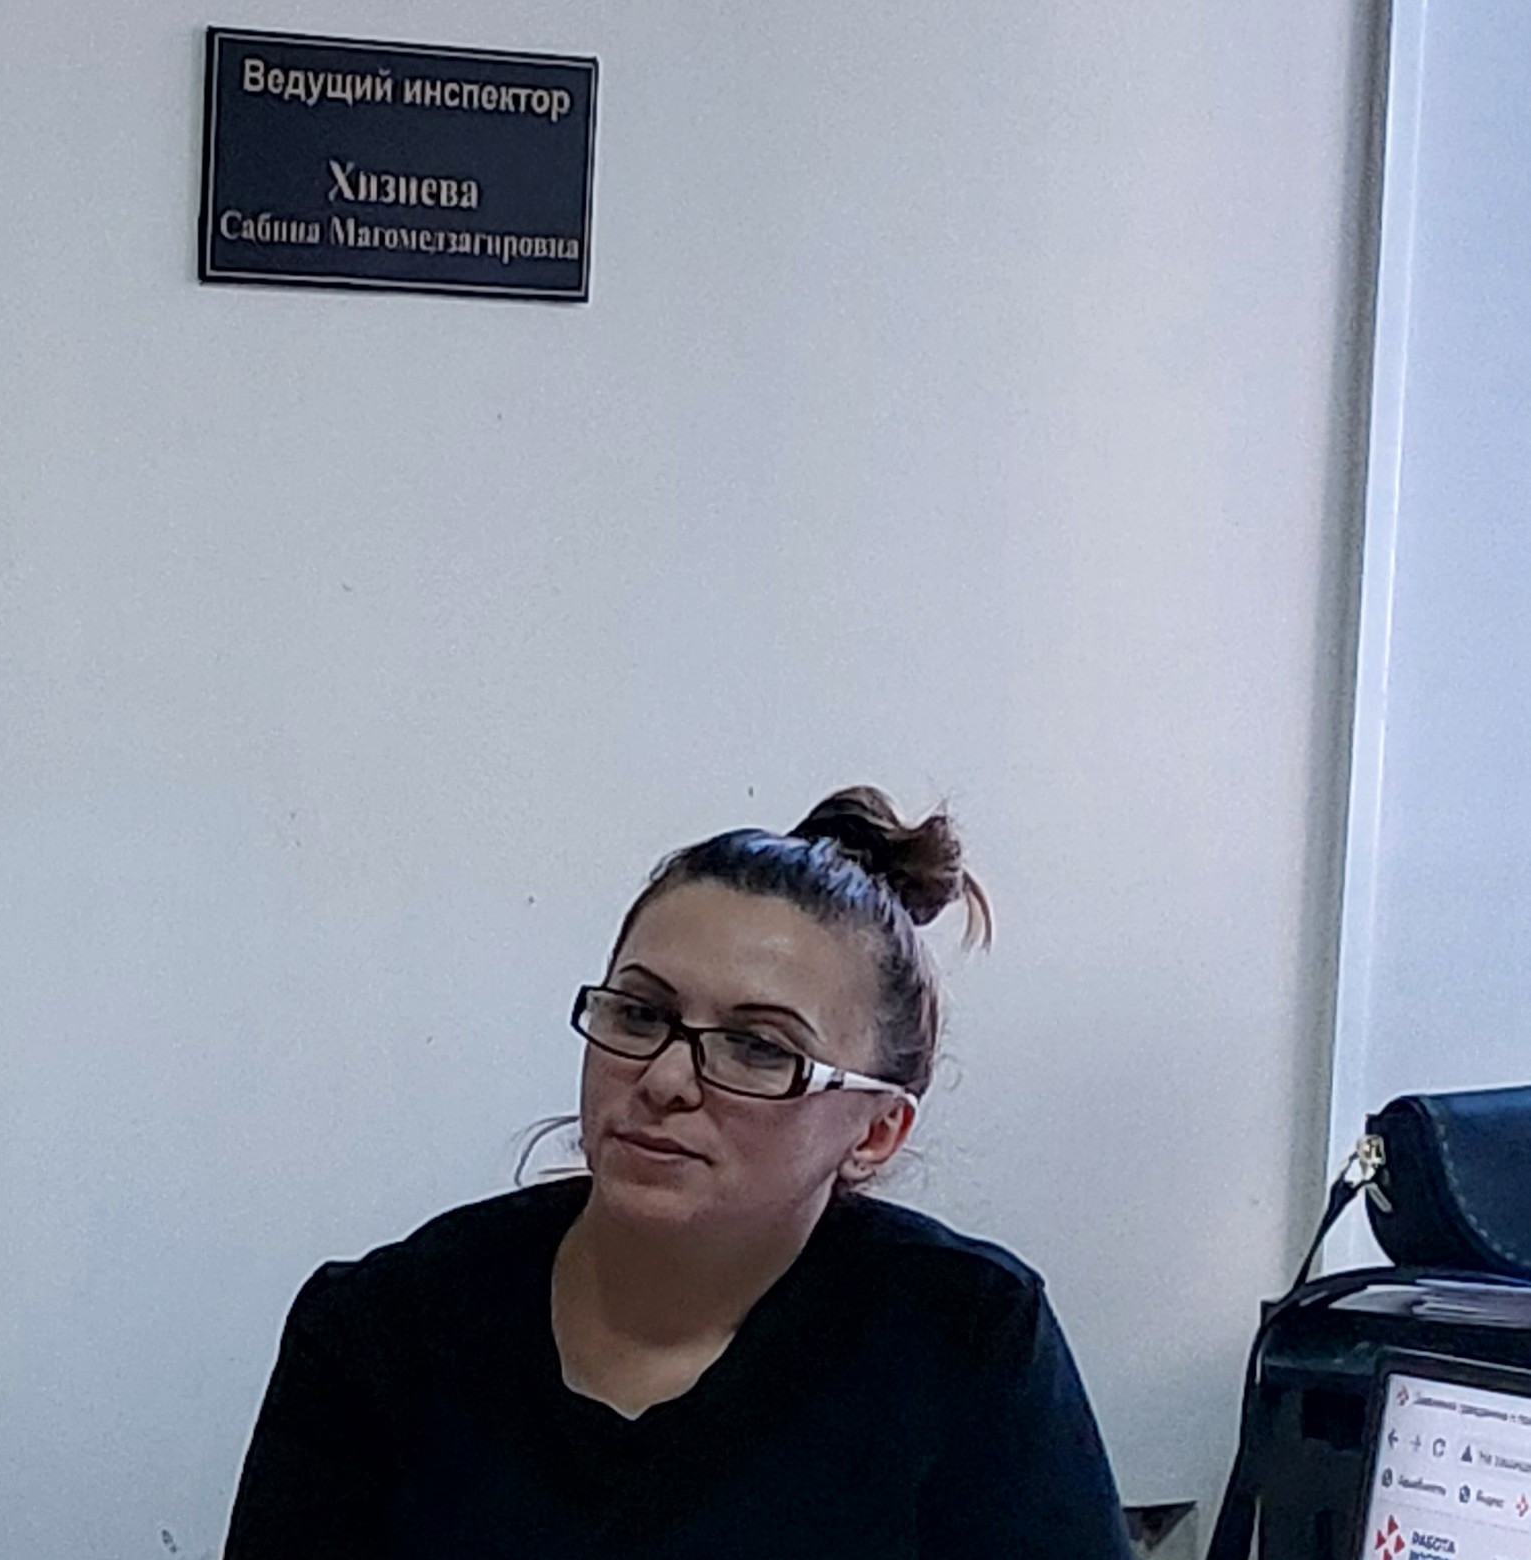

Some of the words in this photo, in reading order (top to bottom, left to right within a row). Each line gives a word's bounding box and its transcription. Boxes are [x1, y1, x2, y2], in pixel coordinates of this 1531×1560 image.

[243, 57, 393, 108] Ведущий
[403, 77, 571, 122] инспектор
[327, 159, 479, 211] Хизнева
[219, 209, 320, 245] Сабина
